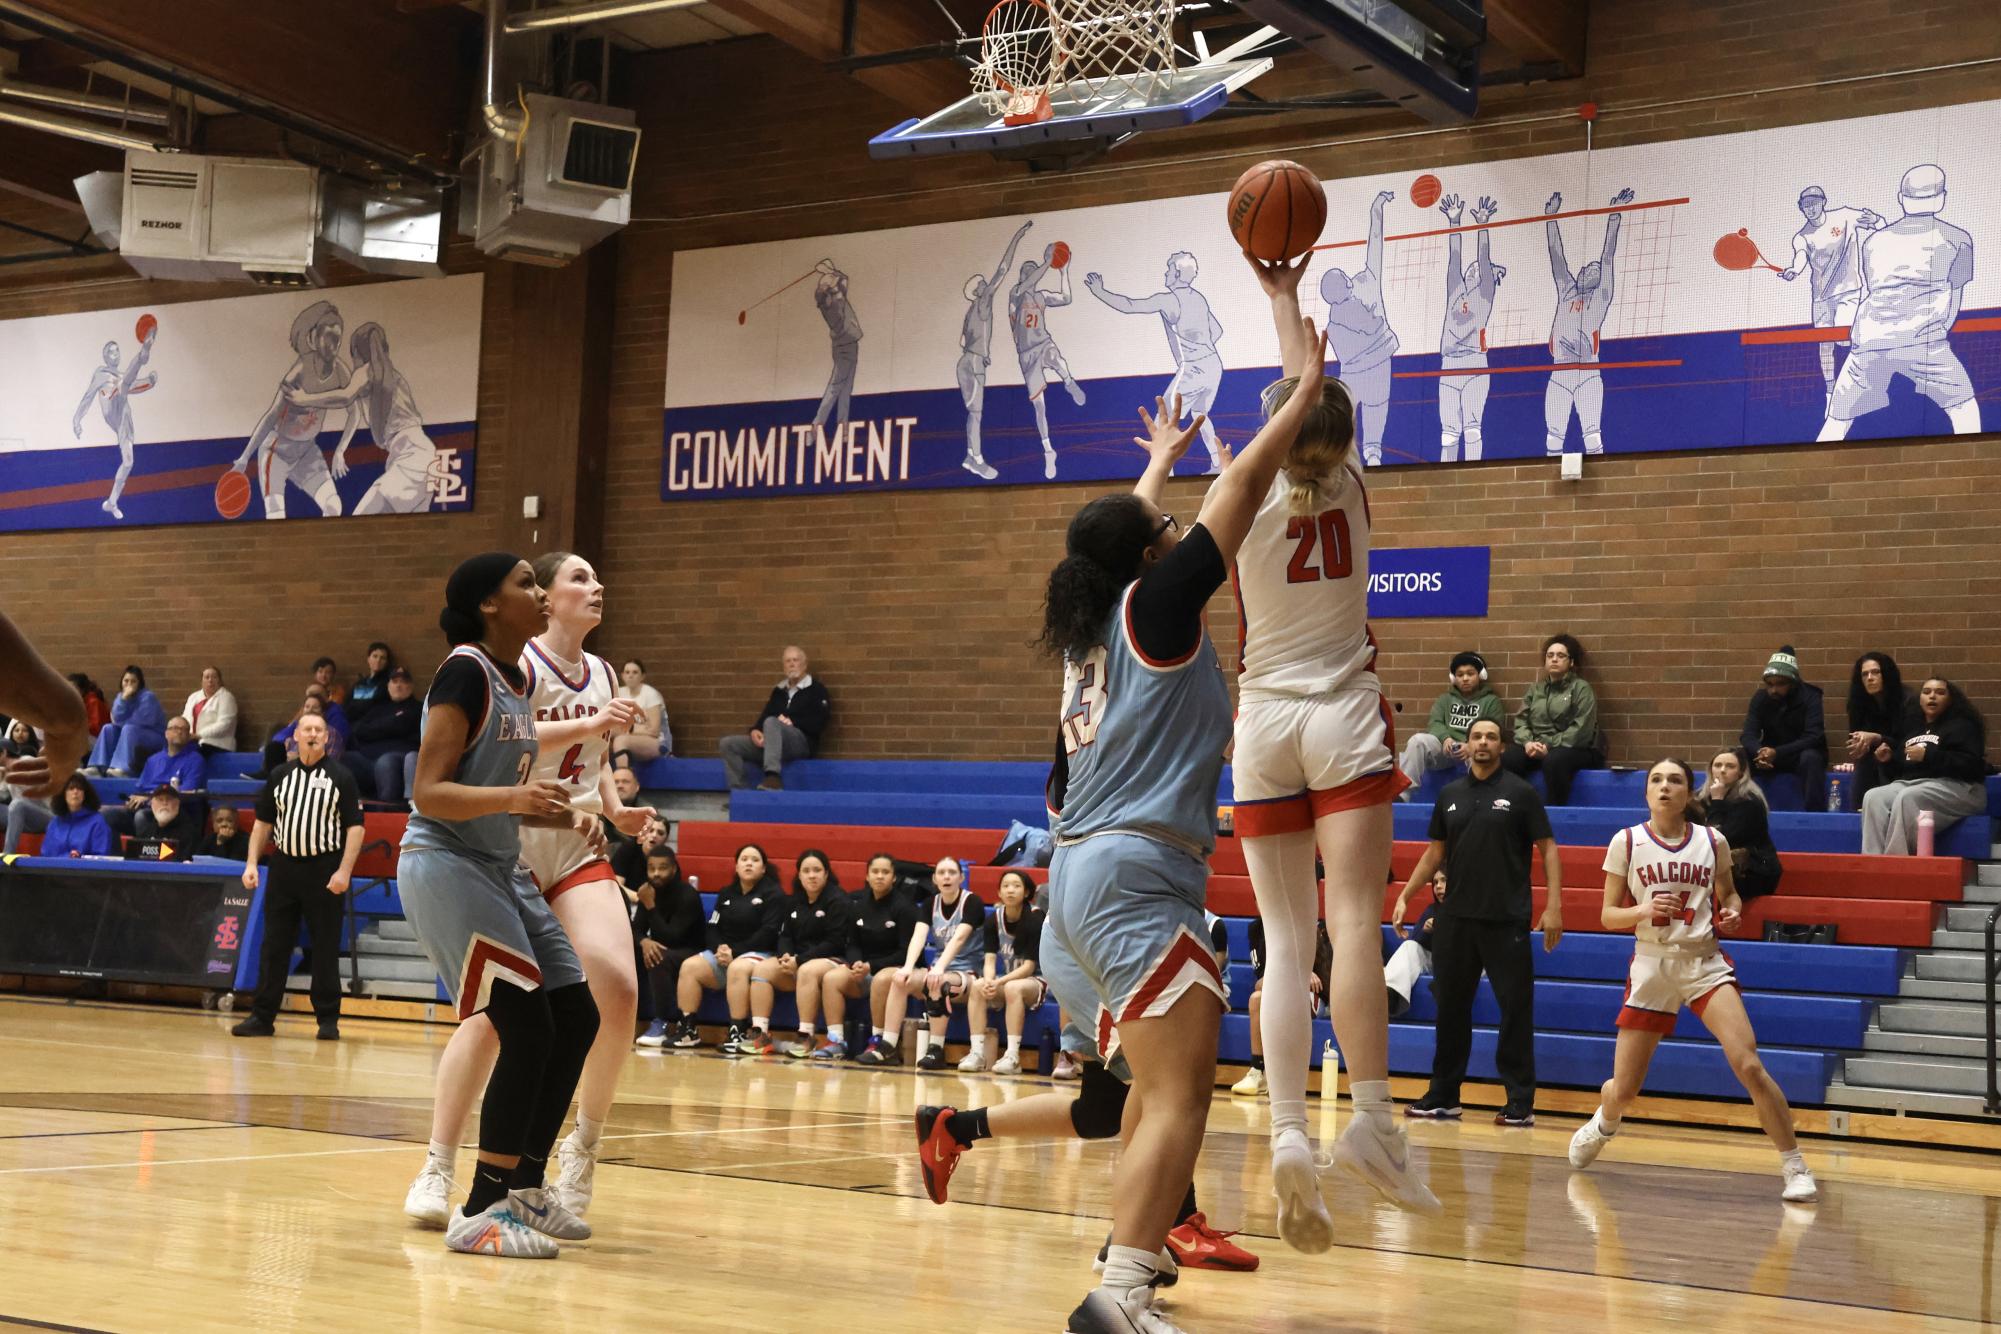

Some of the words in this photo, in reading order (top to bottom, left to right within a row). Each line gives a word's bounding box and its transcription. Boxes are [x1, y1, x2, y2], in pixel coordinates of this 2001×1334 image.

[141, 220, 182, 230] REZNOR
[1025, 313, 1039, 329] 21
[668, 416, 918, 491] COMMITMENT
[1286, 508, 1353, 584] 20
[1450, 703, 1479, 718] GAME
[1450, 716, 1473, 728] DAY
[557, 743, 586, 785] 4
[1636, 861, 1711, 888] FALCONS
